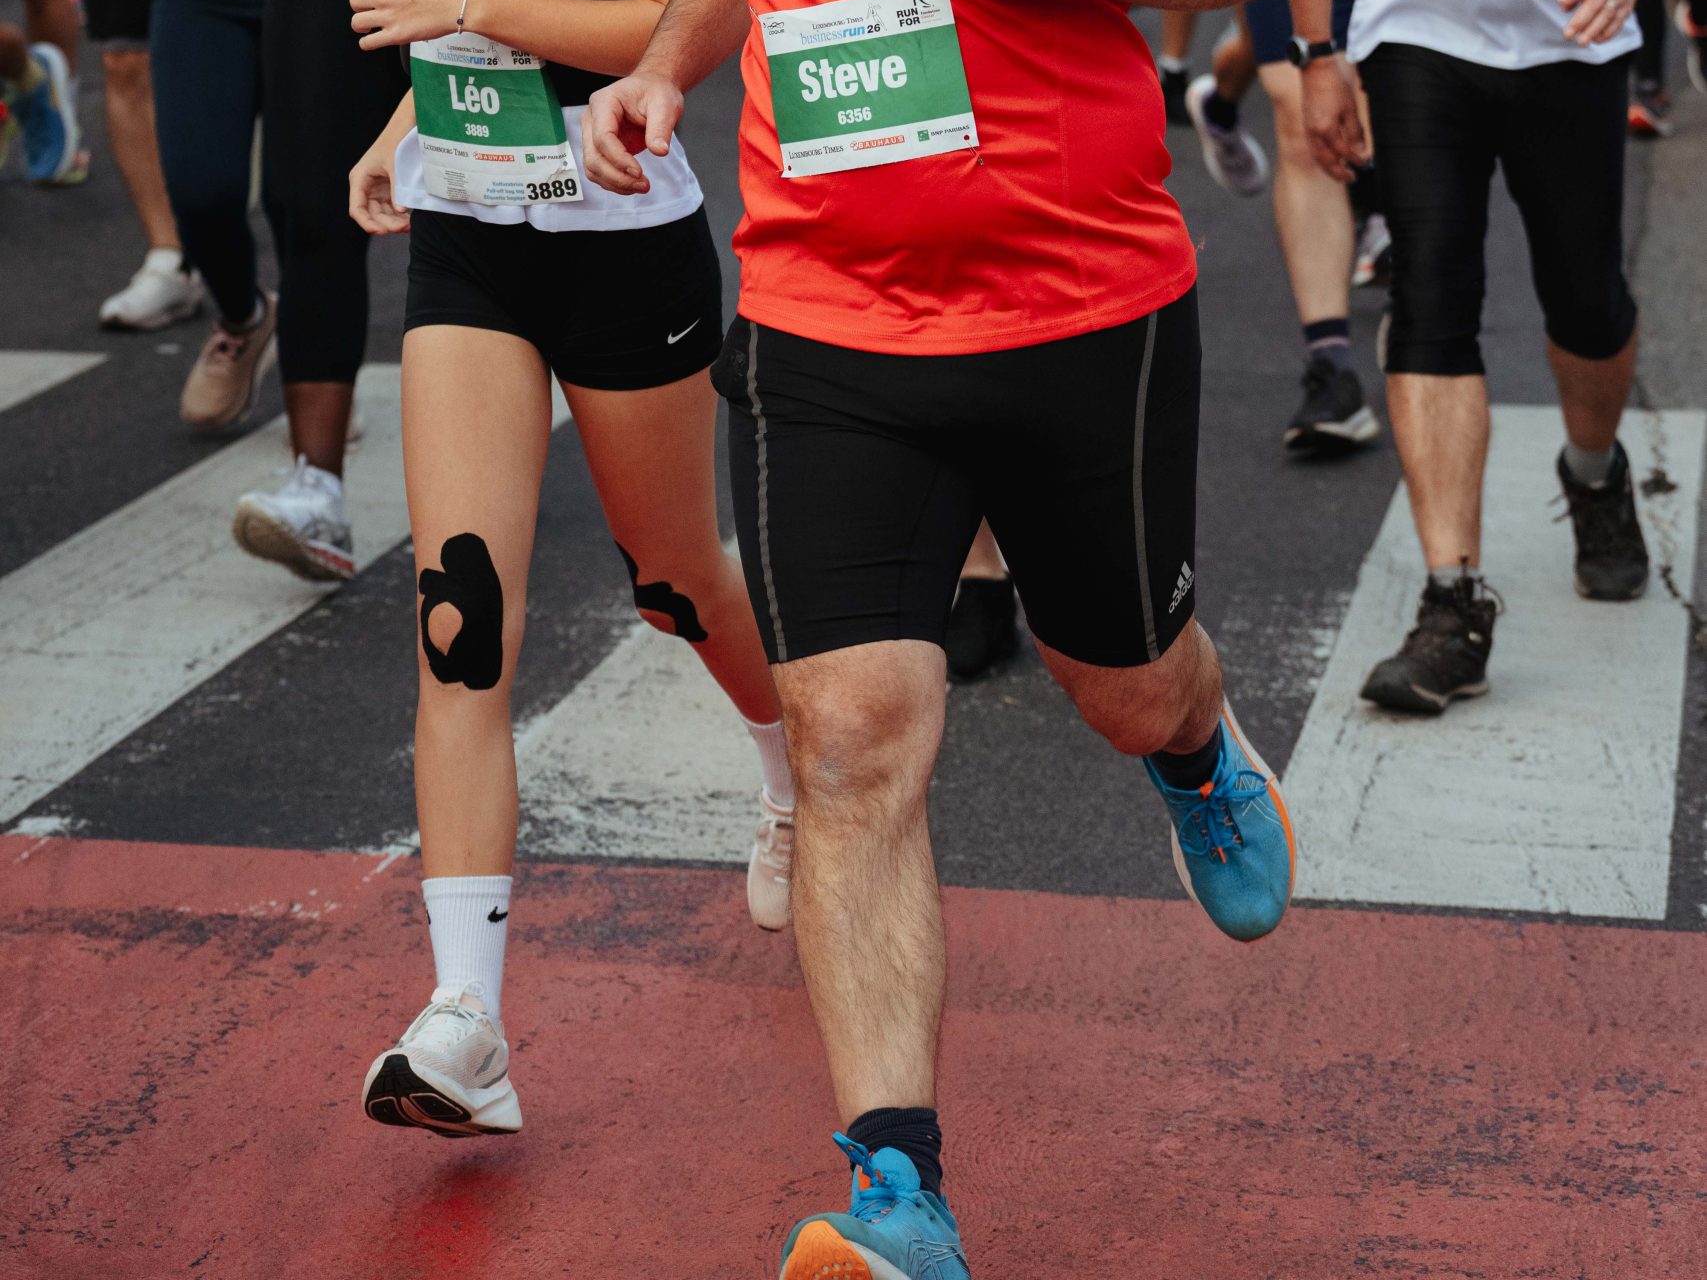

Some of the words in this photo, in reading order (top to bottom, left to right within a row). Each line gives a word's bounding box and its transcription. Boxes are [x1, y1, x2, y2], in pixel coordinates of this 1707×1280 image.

[896, 7, 919, 19] RUN
[847, 16, 864, 25] TIMES
[899, 16, 921, 27] FOR
[867, 23, 881, 34] 26
[487, 57, 498, 66] 26
[513, 57, 532, 65] FOR
[799, 55, 907, 103] Steve
[448, 74, 500, 115] Léo
[837, 106, 872, 125] 6356
[465, 123, 490, 138] 3889
[944, 124, 970, 135] PARIBAS
[858, 136, 904, 149] BAUHAUS
[823, 145, 844, 155] TIMES
[479, 153, 514, 161] BAUHAUS
[526, 178, 578, 201] 3889
